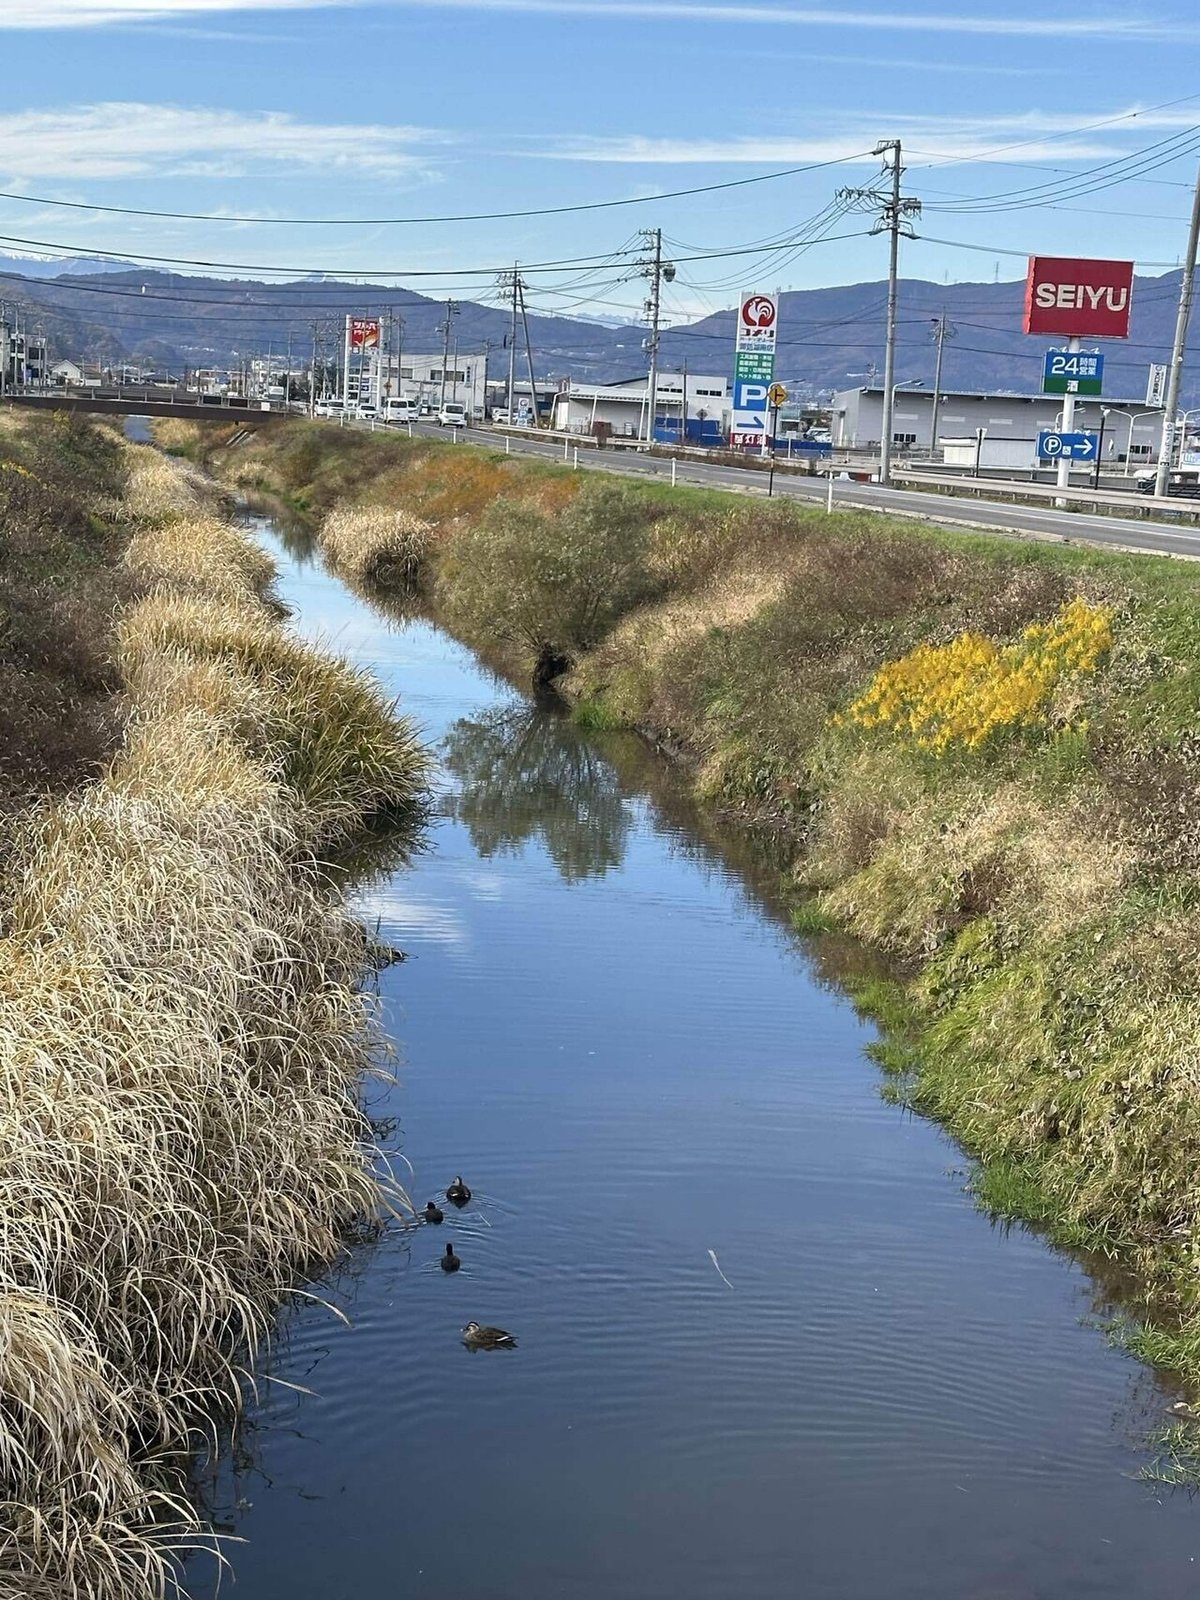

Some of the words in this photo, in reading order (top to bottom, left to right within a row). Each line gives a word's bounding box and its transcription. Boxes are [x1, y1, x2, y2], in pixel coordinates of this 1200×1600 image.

[1035, 283, 1127, 312] SEIYU
[739, 328, 774, 337] コメリ
[1052, 356, 1079, 375] 24
[1079, 357, 1097, 367] 時間
[1079, 367, 1097, 376] 営業
[1067, 380, 1079, 392] 酒
[740, 384, 767, 406] P
